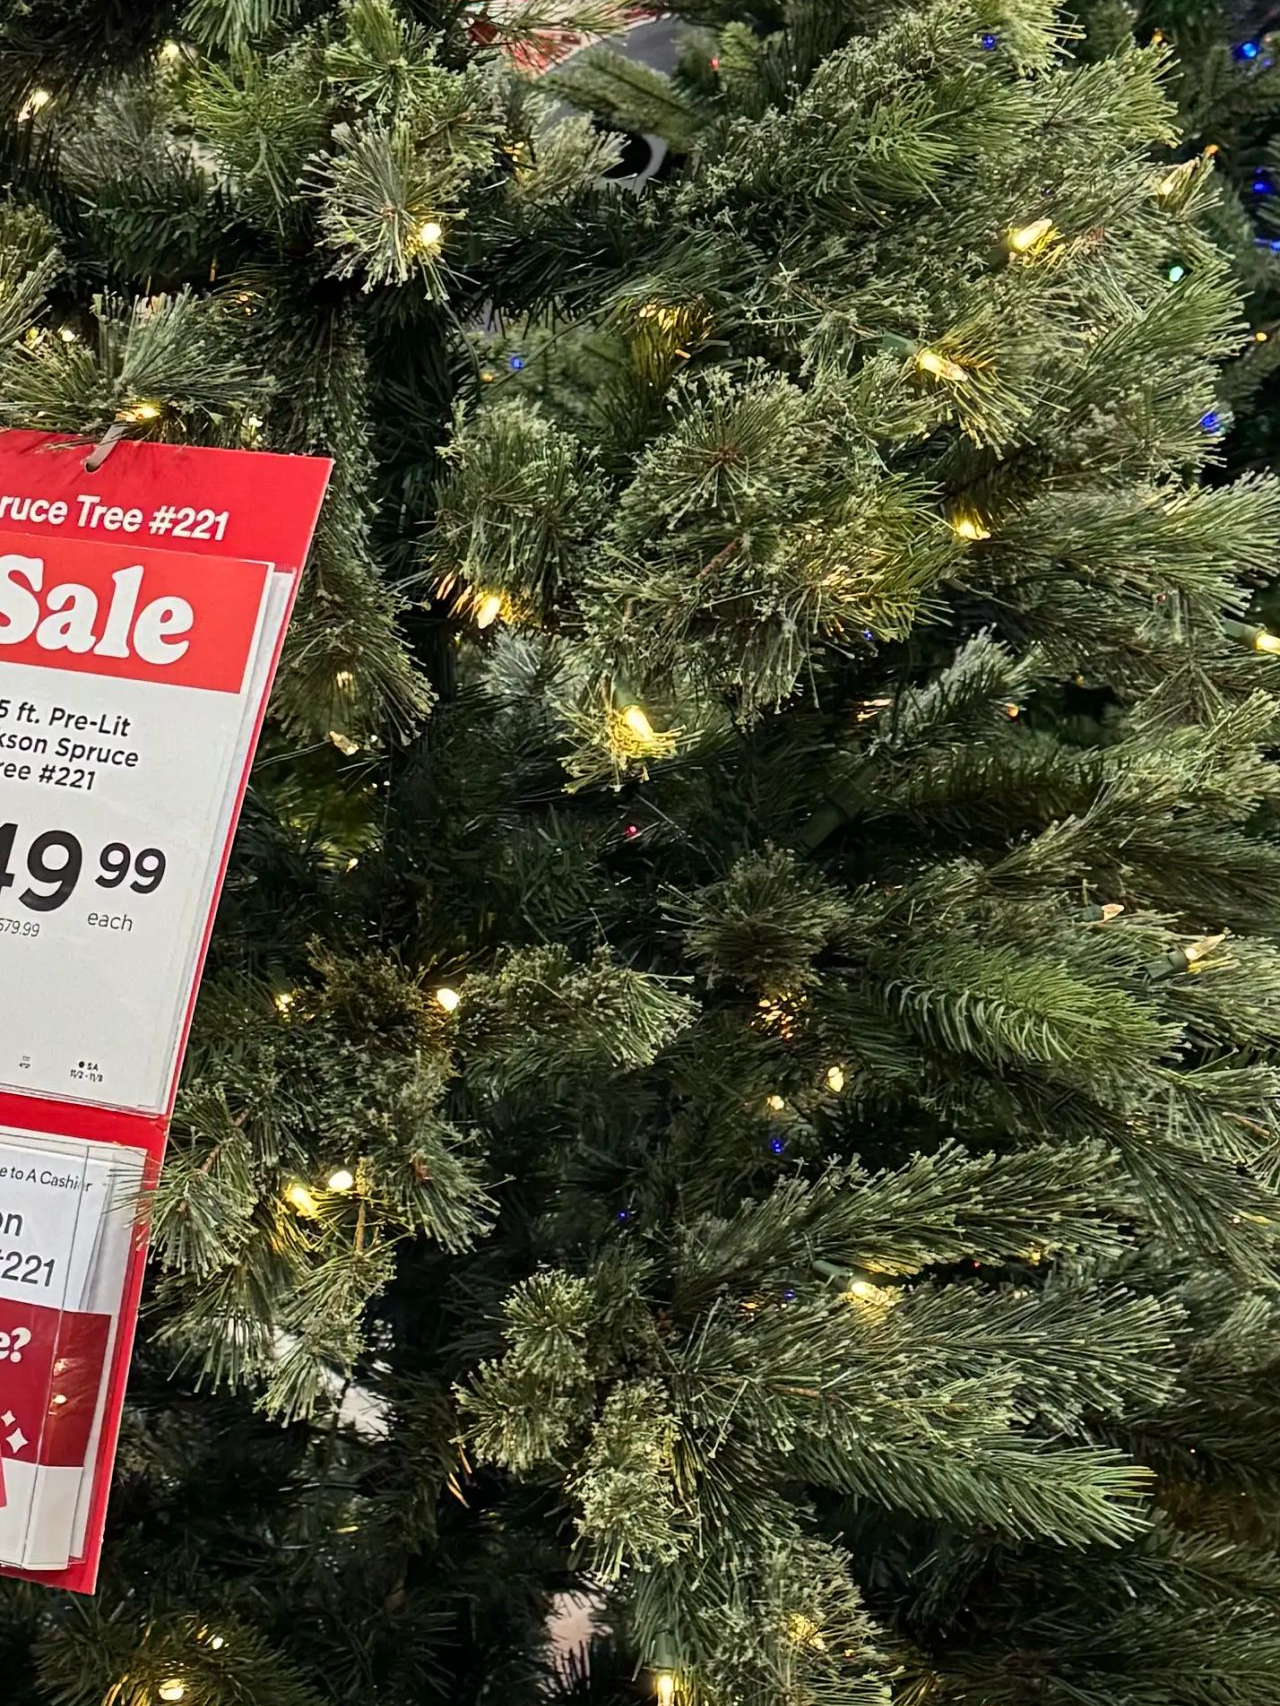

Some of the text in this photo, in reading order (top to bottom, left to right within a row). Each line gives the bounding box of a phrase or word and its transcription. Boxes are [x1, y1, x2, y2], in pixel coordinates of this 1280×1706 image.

[76, 493, 143, 533] Tree
[147, 504, 229, 541] #221
[15, 700, 40, 724] ft.
[47, 706, 131, 737] Pre-Lit
[53, 736, 139, 768] Spruce
[37, 763, 96, 791] #221
[86, 911, 133, 932] each
[9, 1165, 24, 1180] to
[24, 1167, 37, 1183] A
